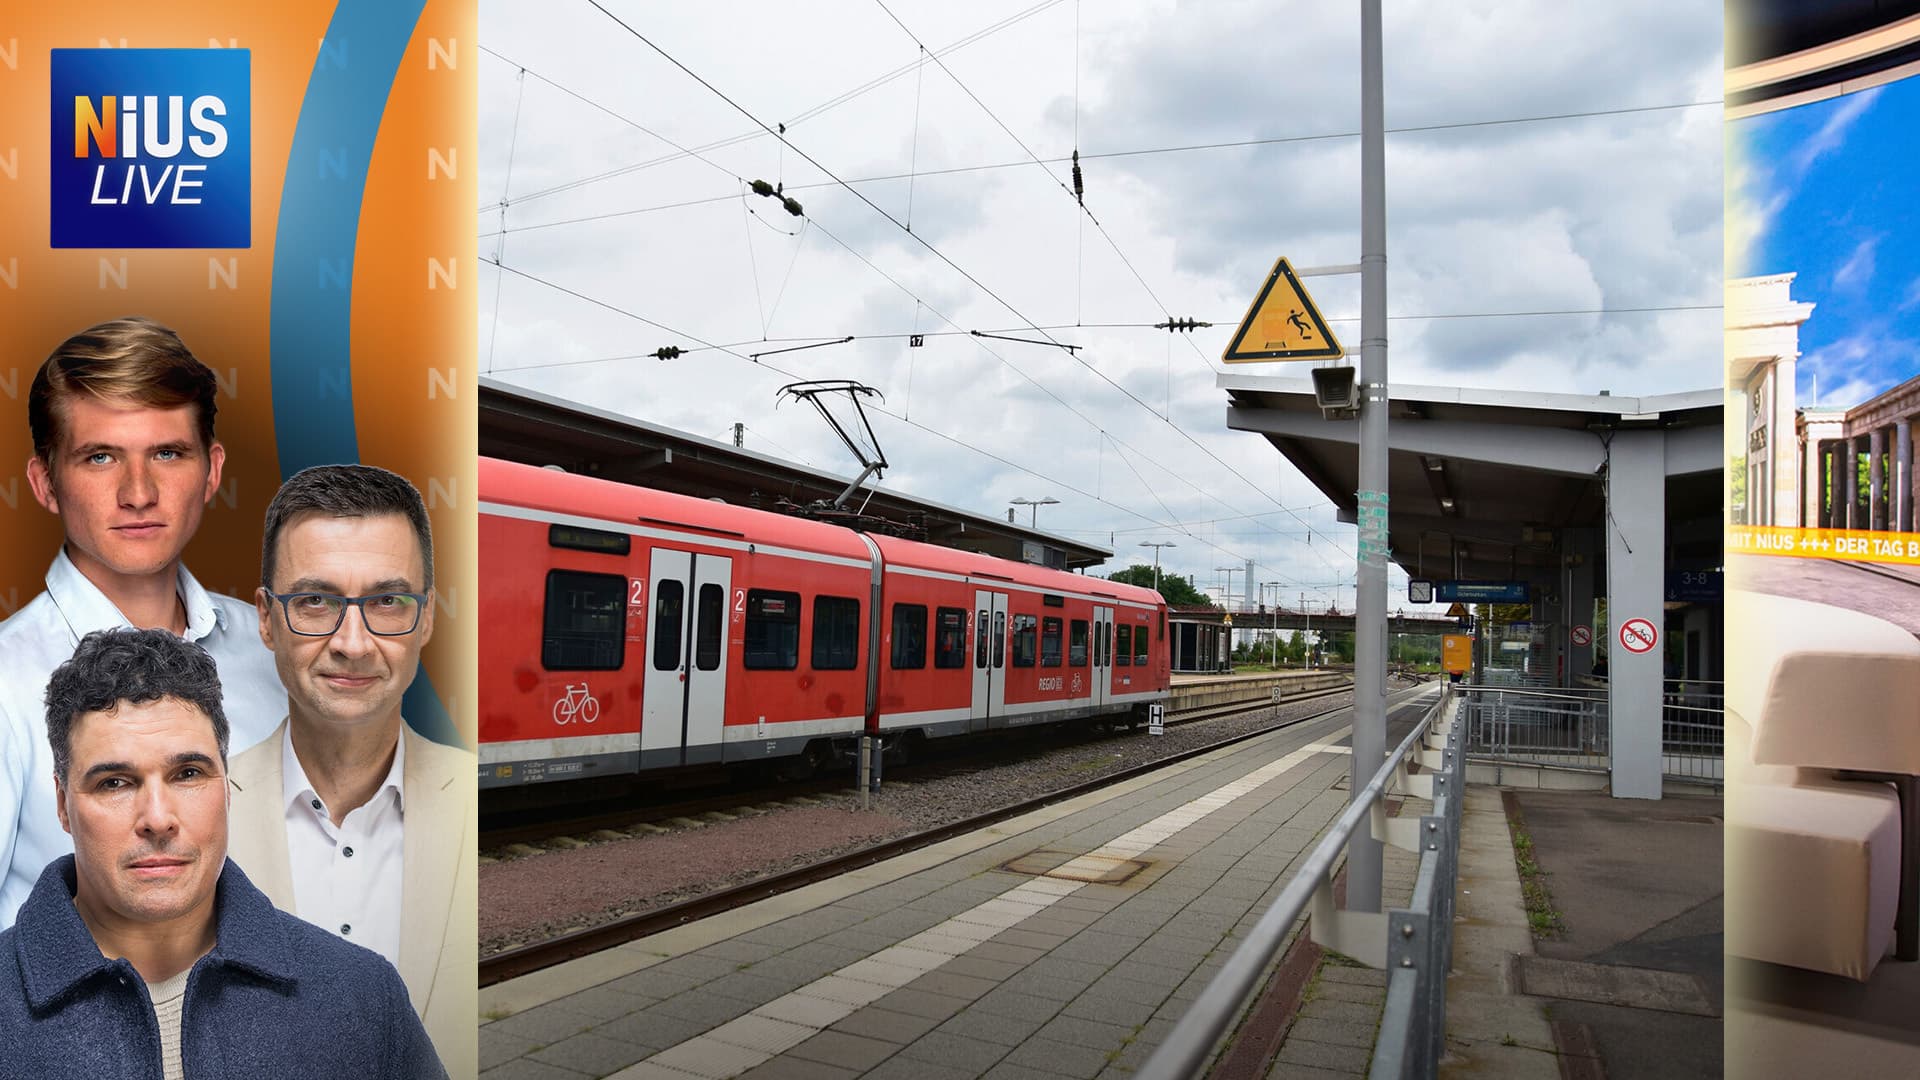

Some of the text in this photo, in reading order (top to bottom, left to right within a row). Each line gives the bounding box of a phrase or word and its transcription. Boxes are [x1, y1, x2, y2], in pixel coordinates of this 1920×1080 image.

[911, 337, 922, 347] 17
[1756, 534, 1795, 550] NIUS
[1835, 538, 1869, 555] DER
[1872, 540, 1904, 557] TAG
[1681, 571, 1707, 585] 3-8
[631, 580, 643, 605] 2
[735, 590, 745, 612] 2
[967, 611, 974, 627] 2
[1008, 615, 1015, 630] 2
[1038, 677, 1056, 691] REGIO
[1151, 706, 1162, 724] H
